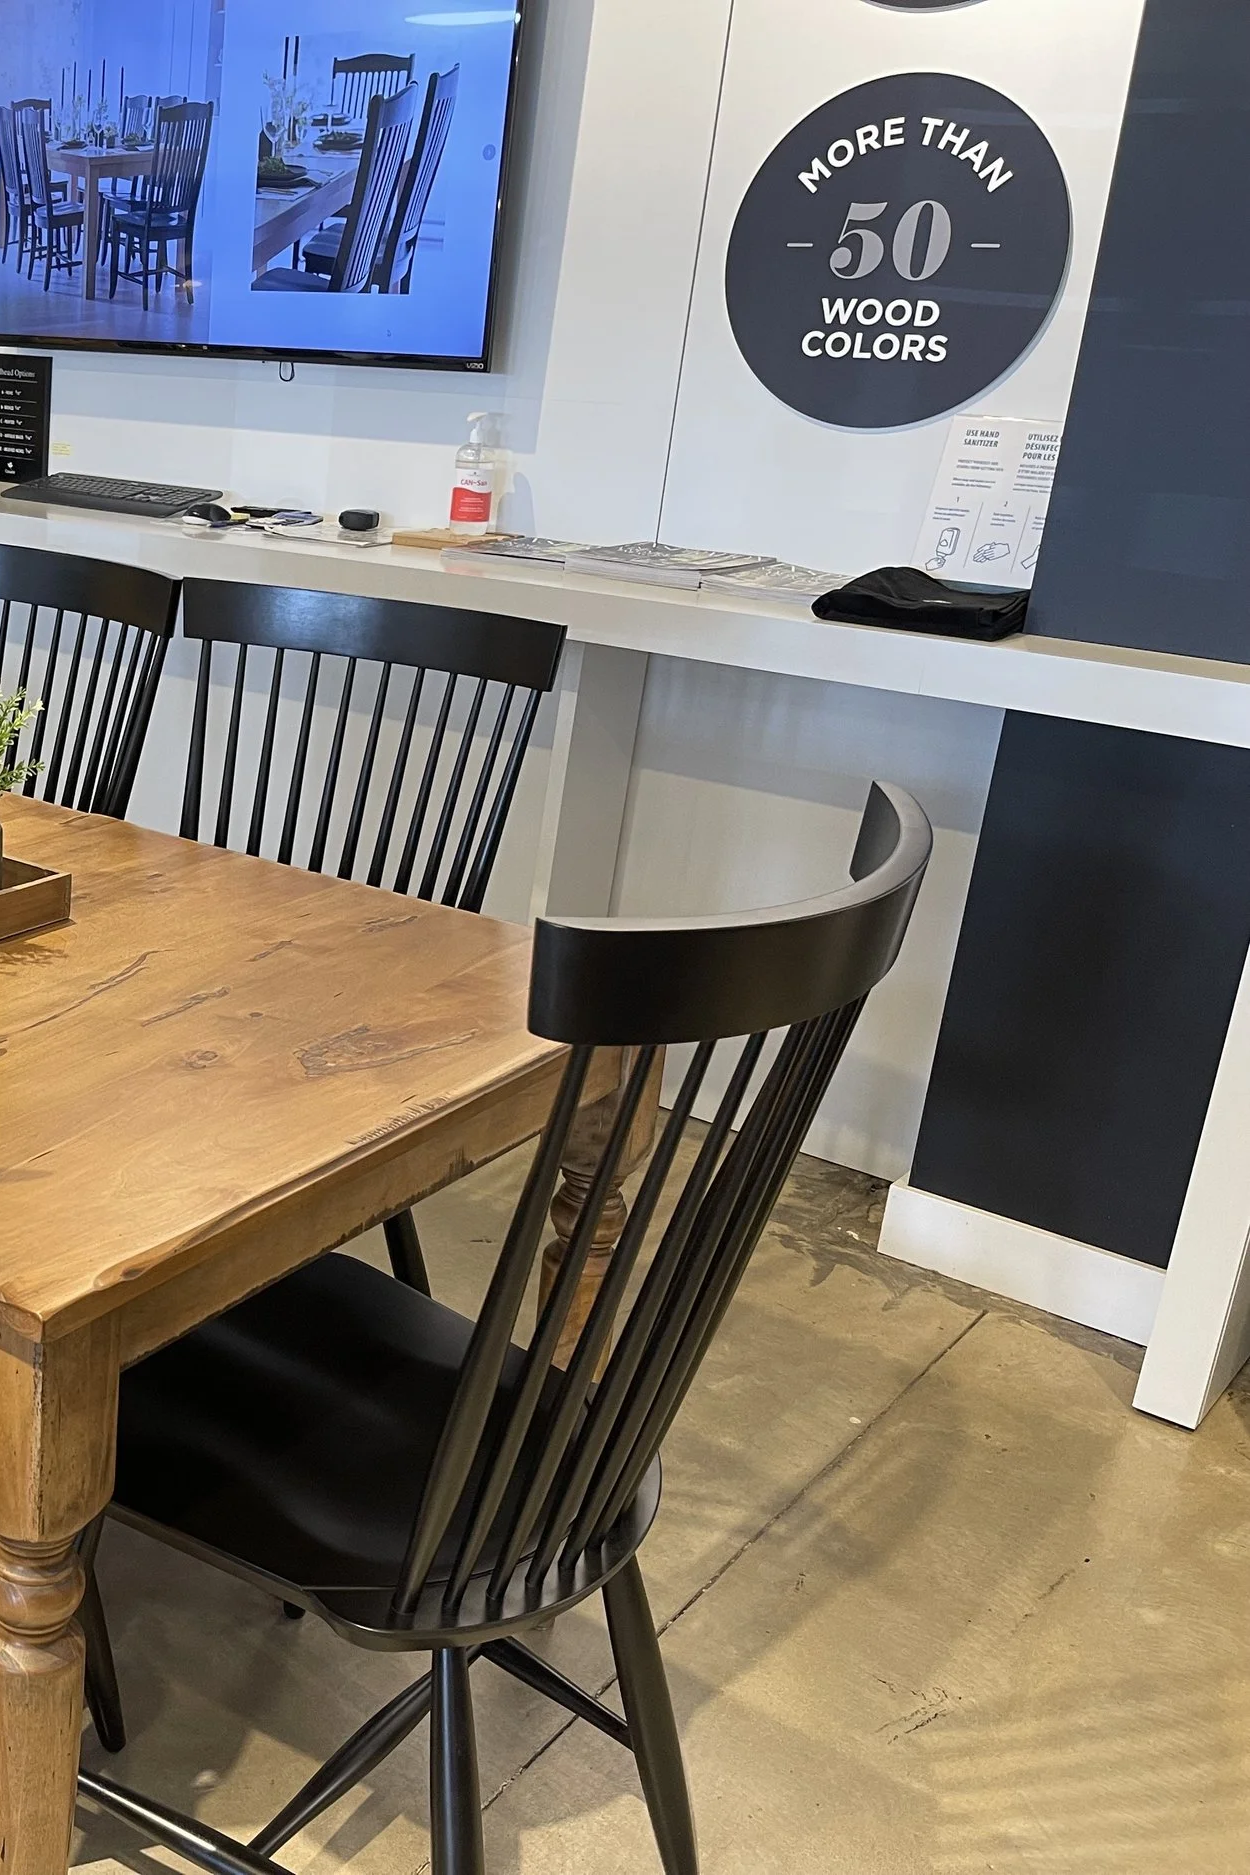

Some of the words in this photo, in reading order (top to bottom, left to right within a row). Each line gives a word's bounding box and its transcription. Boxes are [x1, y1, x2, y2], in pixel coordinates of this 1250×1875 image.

[797, 116, 906, 194] MORE
[920, 115, 1014, 194] THAN
[829, 199, 952, 281] 50
[821, 296, 940, 327] WOOD
[801, 330, 949, 363] COLORS
[963, 438, 999, 448] SANITIZER
[965, 429, 979, 437] USE
[979, 429, 1000, 438] HAND
[1027, 433, 1059, 443] UTILISEZ
[1022, 452, 1042, 460] POUR
[1043, 453, 1056, 461] LES
